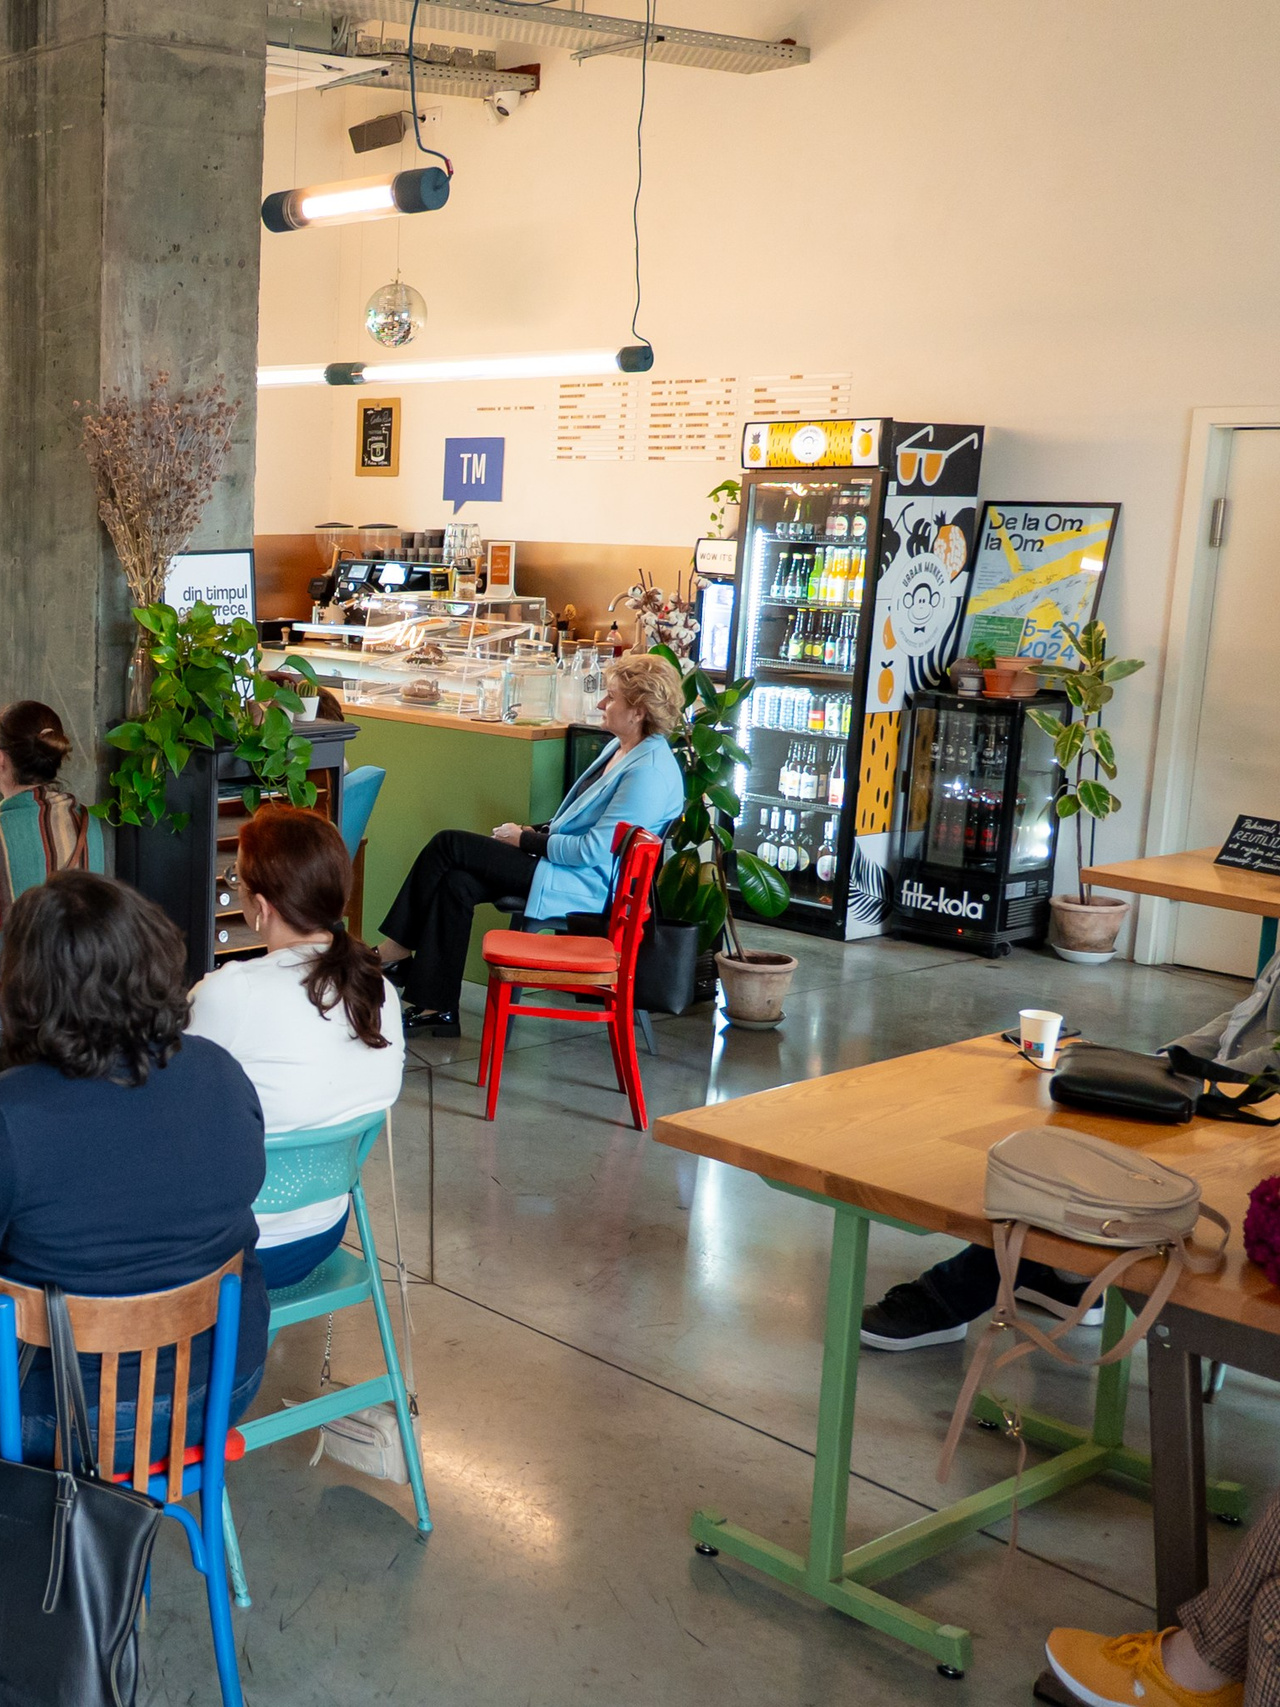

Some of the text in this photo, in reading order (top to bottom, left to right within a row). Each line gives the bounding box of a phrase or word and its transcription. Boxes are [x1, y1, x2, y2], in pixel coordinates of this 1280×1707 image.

[460, 453, 486, 484] TM
[989, 512, 1083, 532] De la Om
[984, 533, 1044, 552] la Om
[902, 562, 923, 587] URBAN
[924, 561, 945, 587] MONKEY
[183, 584, 248, 604] din timpul
[1018, 641, 1074, 661] 2024
[901, 879, 983, 920] fritz-kola
